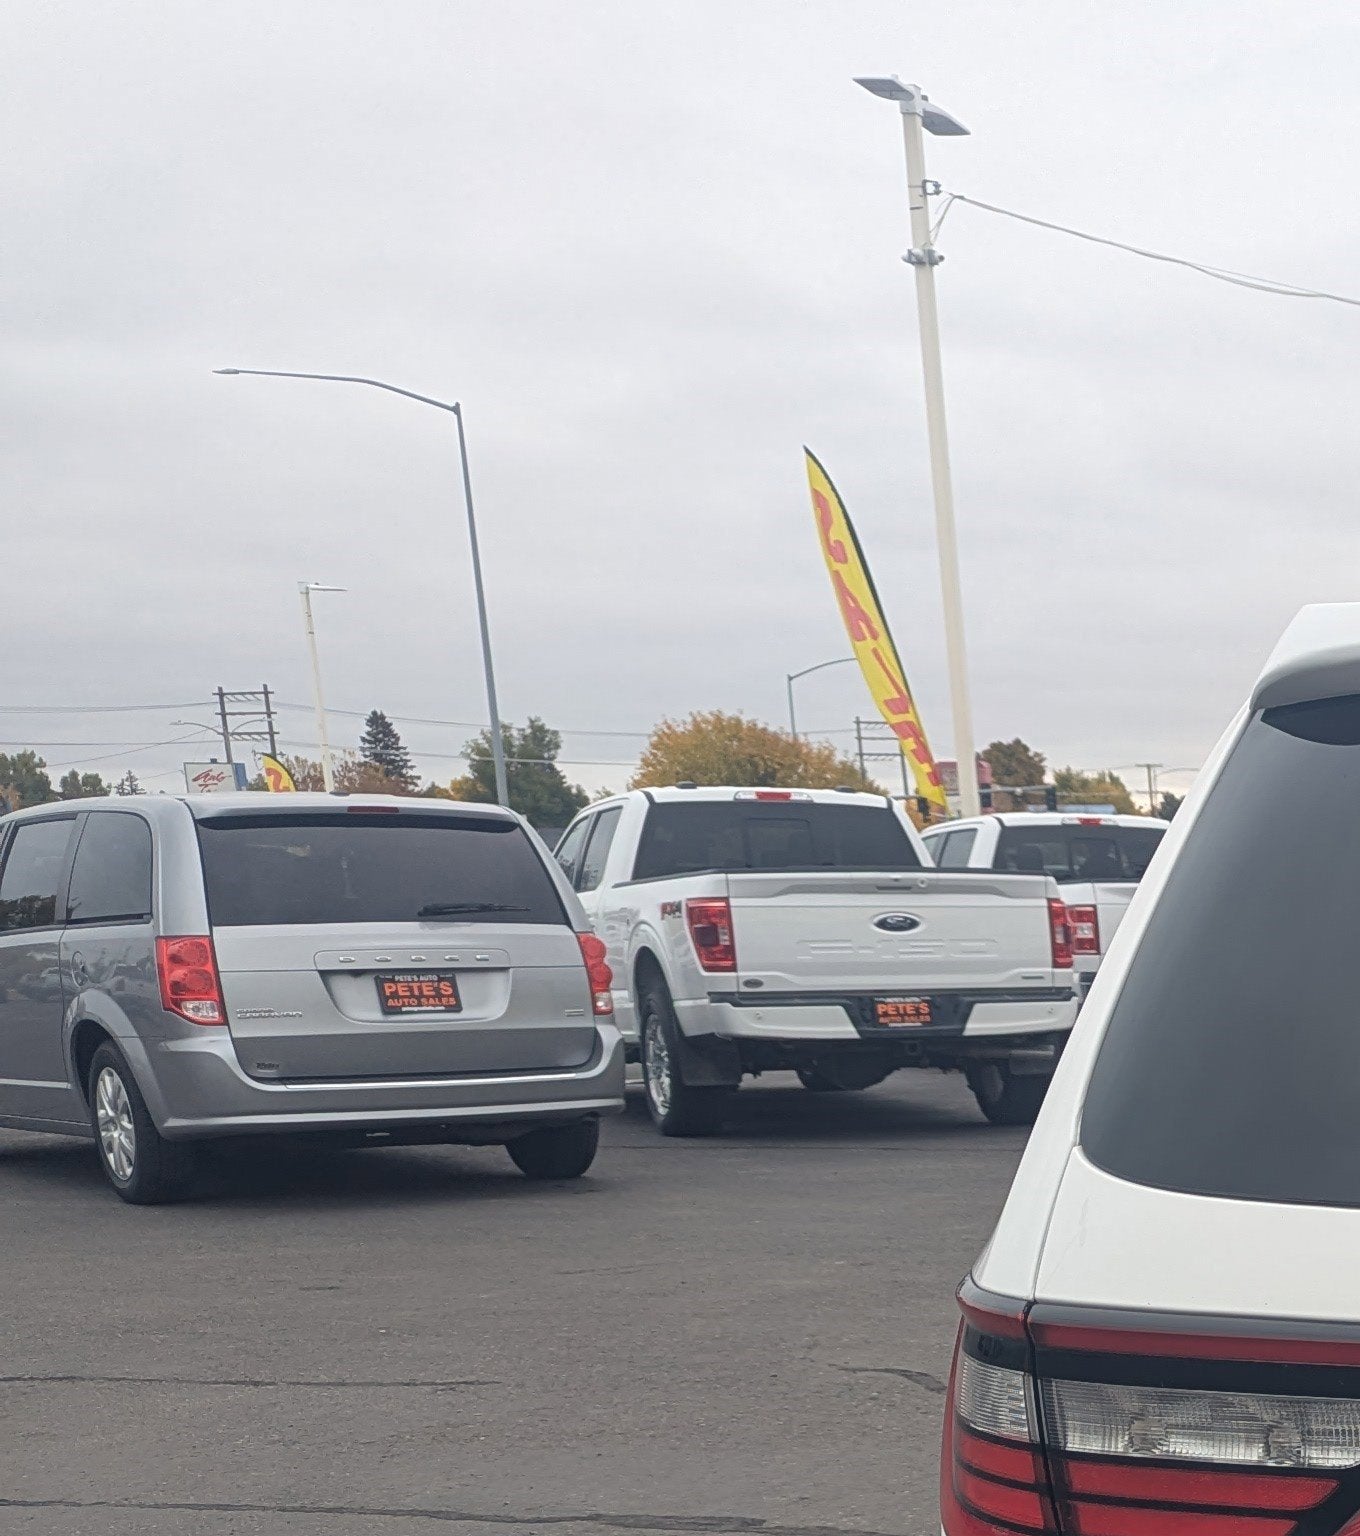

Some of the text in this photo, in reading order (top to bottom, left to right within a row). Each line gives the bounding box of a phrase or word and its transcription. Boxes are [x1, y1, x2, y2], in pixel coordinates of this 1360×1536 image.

[384, 981, 453, 996] PETE'S
[387, 997, 456, 1007] AUTO SALES
